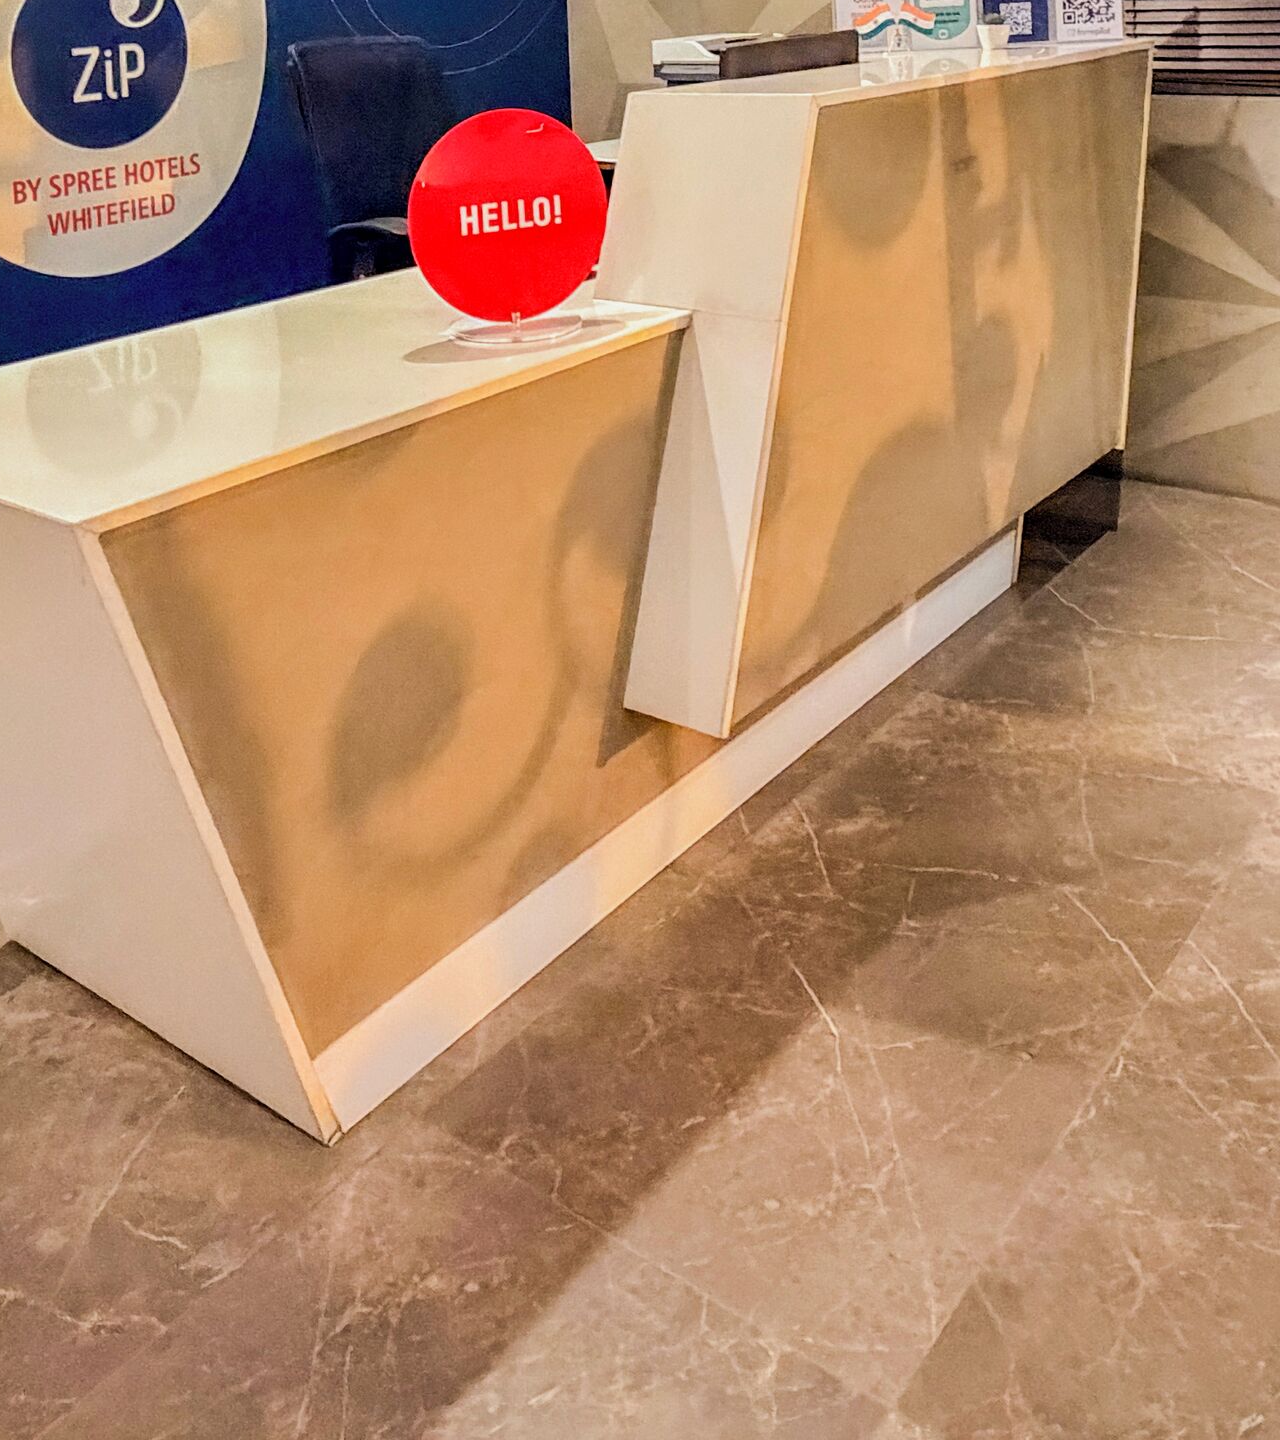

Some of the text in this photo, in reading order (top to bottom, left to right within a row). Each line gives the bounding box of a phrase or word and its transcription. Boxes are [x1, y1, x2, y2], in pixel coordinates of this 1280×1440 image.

[12, 153, 201, 205] BY SPREE HOTELS
[47, 193, 176, 237] WHITEFIELD
[459, 194, 562, 236] HELLO!
